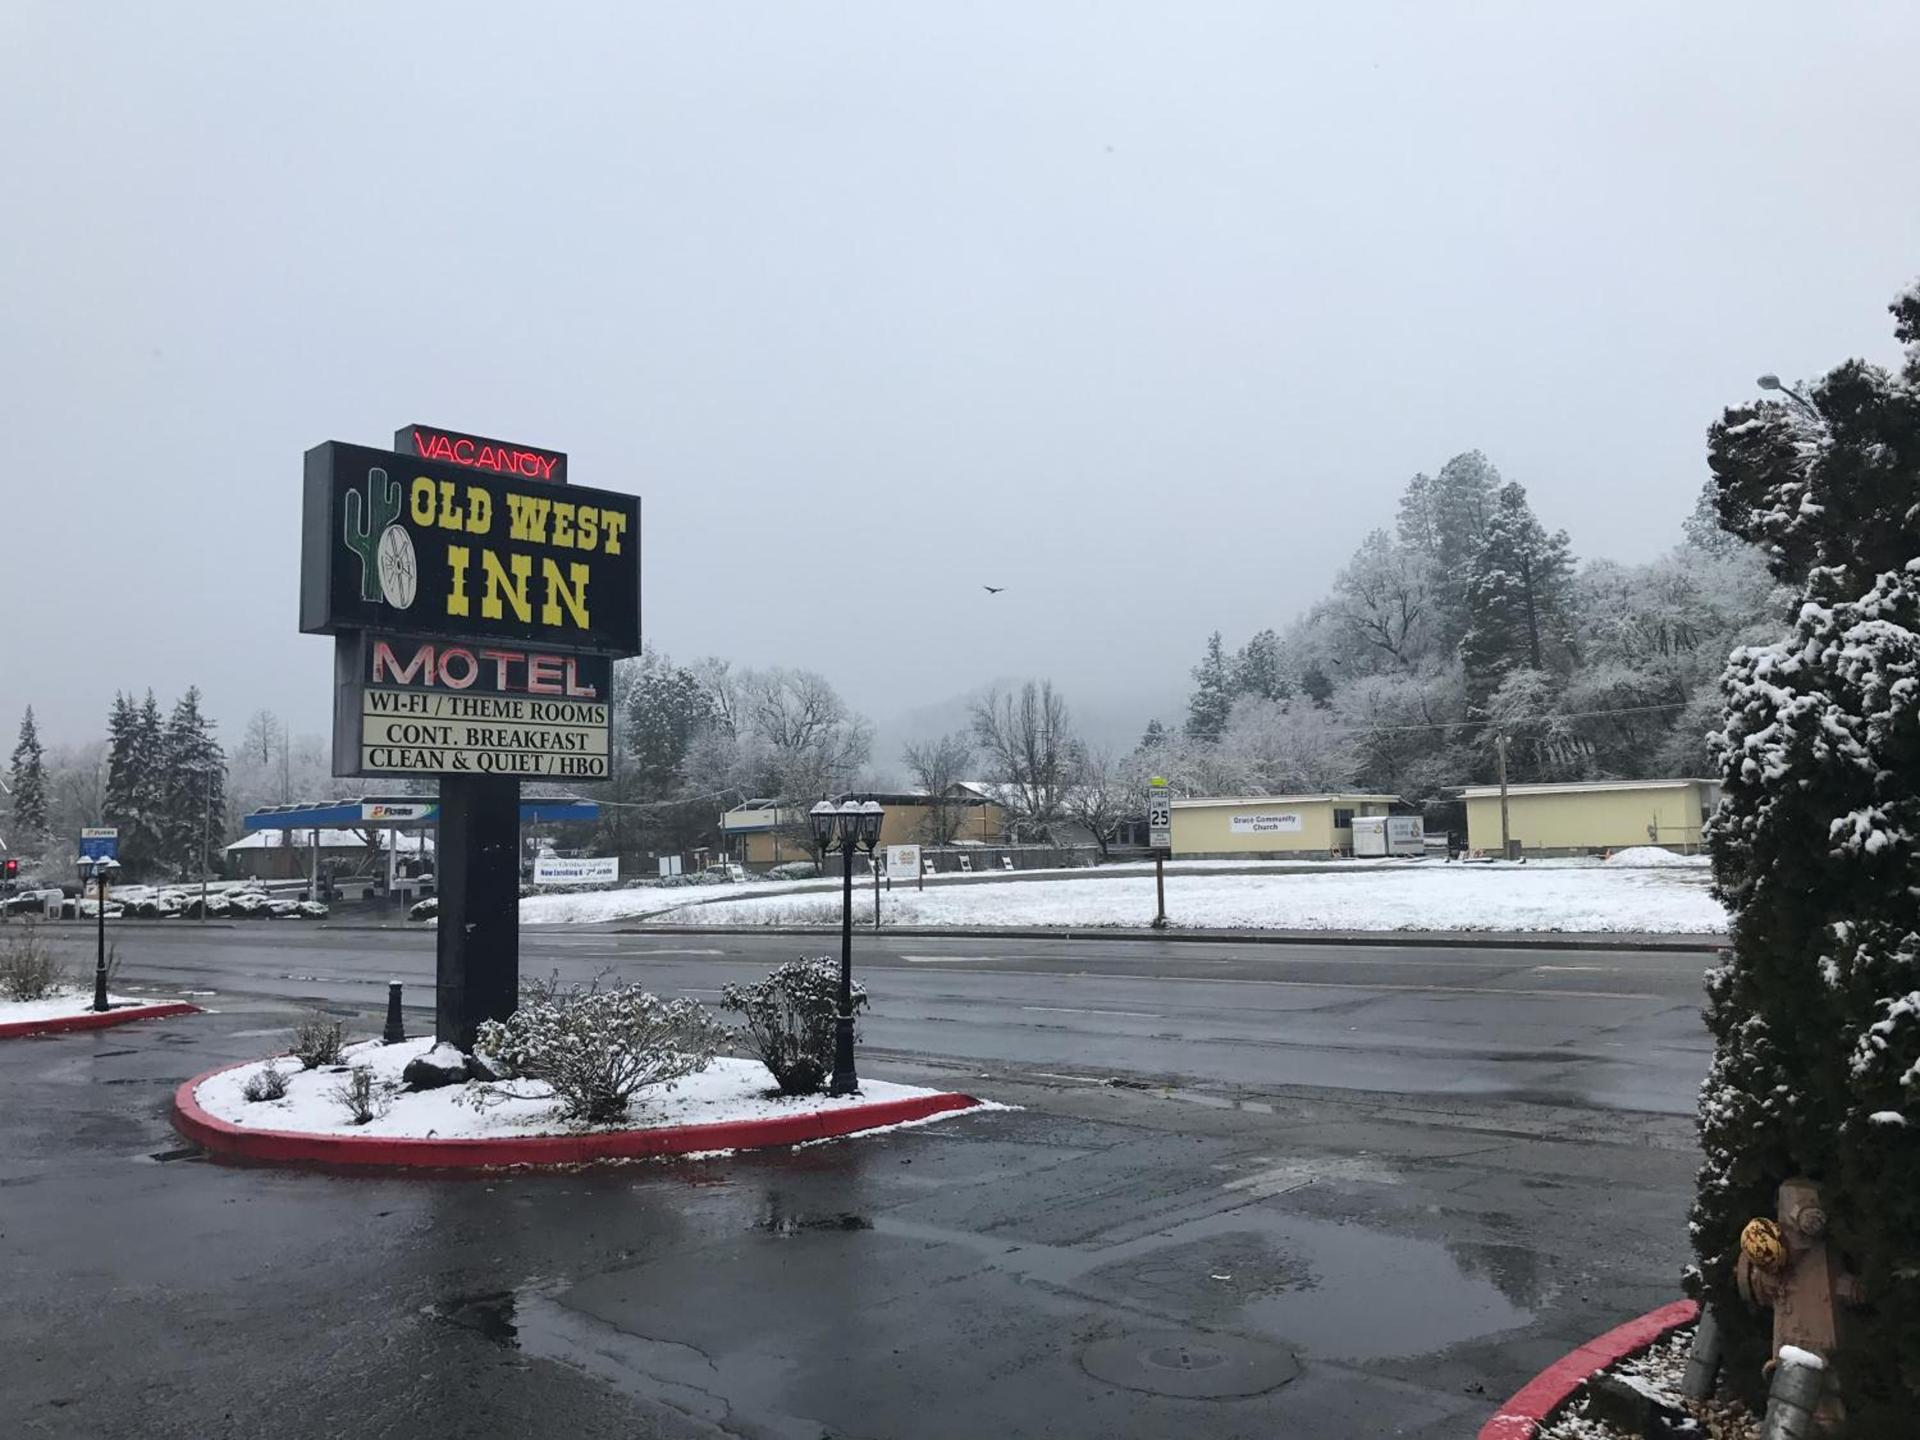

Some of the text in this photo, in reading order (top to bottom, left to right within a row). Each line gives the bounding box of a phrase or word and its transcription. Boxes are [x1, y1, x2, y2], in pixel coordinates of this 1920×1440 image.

[414, 431, 557, 480] VACANCY
[410, 476, 627, 556] OLD WEST
[446, 544, 590, 630] INN
[373, 640, 597, 698] MOTEL
[369, 691, 605, 724] WI-FI / THEME ROOMS
[386, 723, 589, 751] CONT. BREAKFAST
[369, 748, 604, 776] CLEAN & QUIET / HBO
[1151, 810, 1168, 825] 25
[1233, 815, 1296, 824] Grace Community
[1252, 823, 1279, 831] Church
